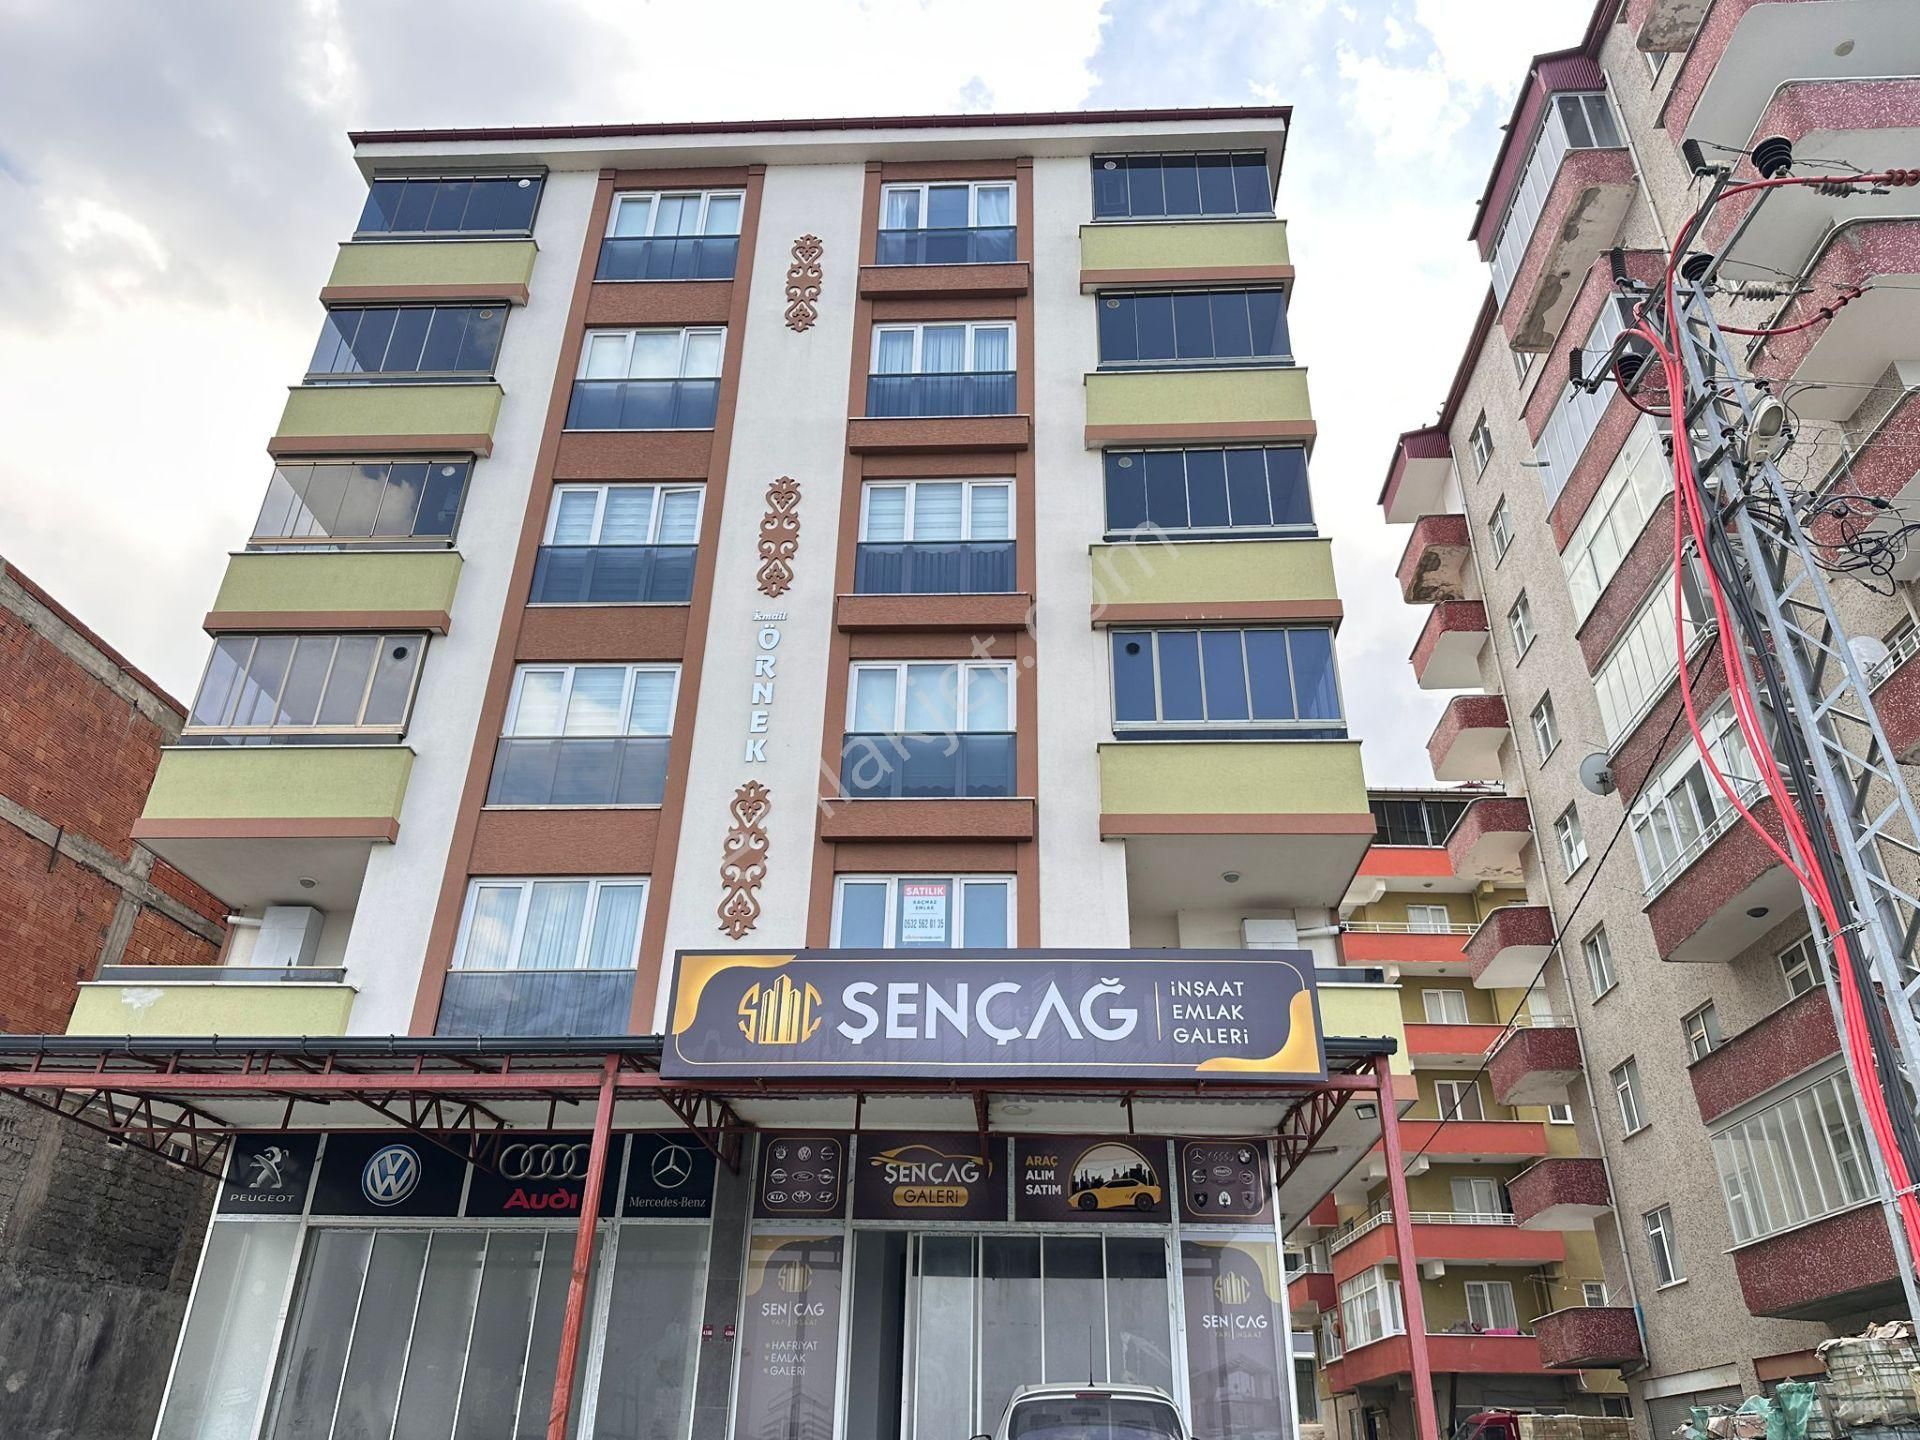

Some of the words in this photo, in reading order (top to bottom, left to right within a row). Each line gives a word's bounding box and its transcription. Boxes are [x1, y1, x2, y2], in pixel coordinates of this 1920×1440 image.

[744, 623, 781, 762] ÖRNEK
[905, 887, 944, 895] SATILIK
[836, 977, 1138, 1045] ŞENÇAĞ
[1172, 1003, 1244, 1020] EMLAK
[1025, 1155, 1058, 1168] ARAÇ
[884, 1161, 980, 1184] ŞENÇAĞ
[1025, 1170, 1055, 1180] ALIM
[1025, 1184, 1062, 1195] SATIM
[230, 1193, 296, 1203] PEUGEOT
[503, 1188, 578, 1210] Audi
[629, 1196, 707, 1208] Mercedes-Benz
[771, 1352, 806, 1363] EMLAK
